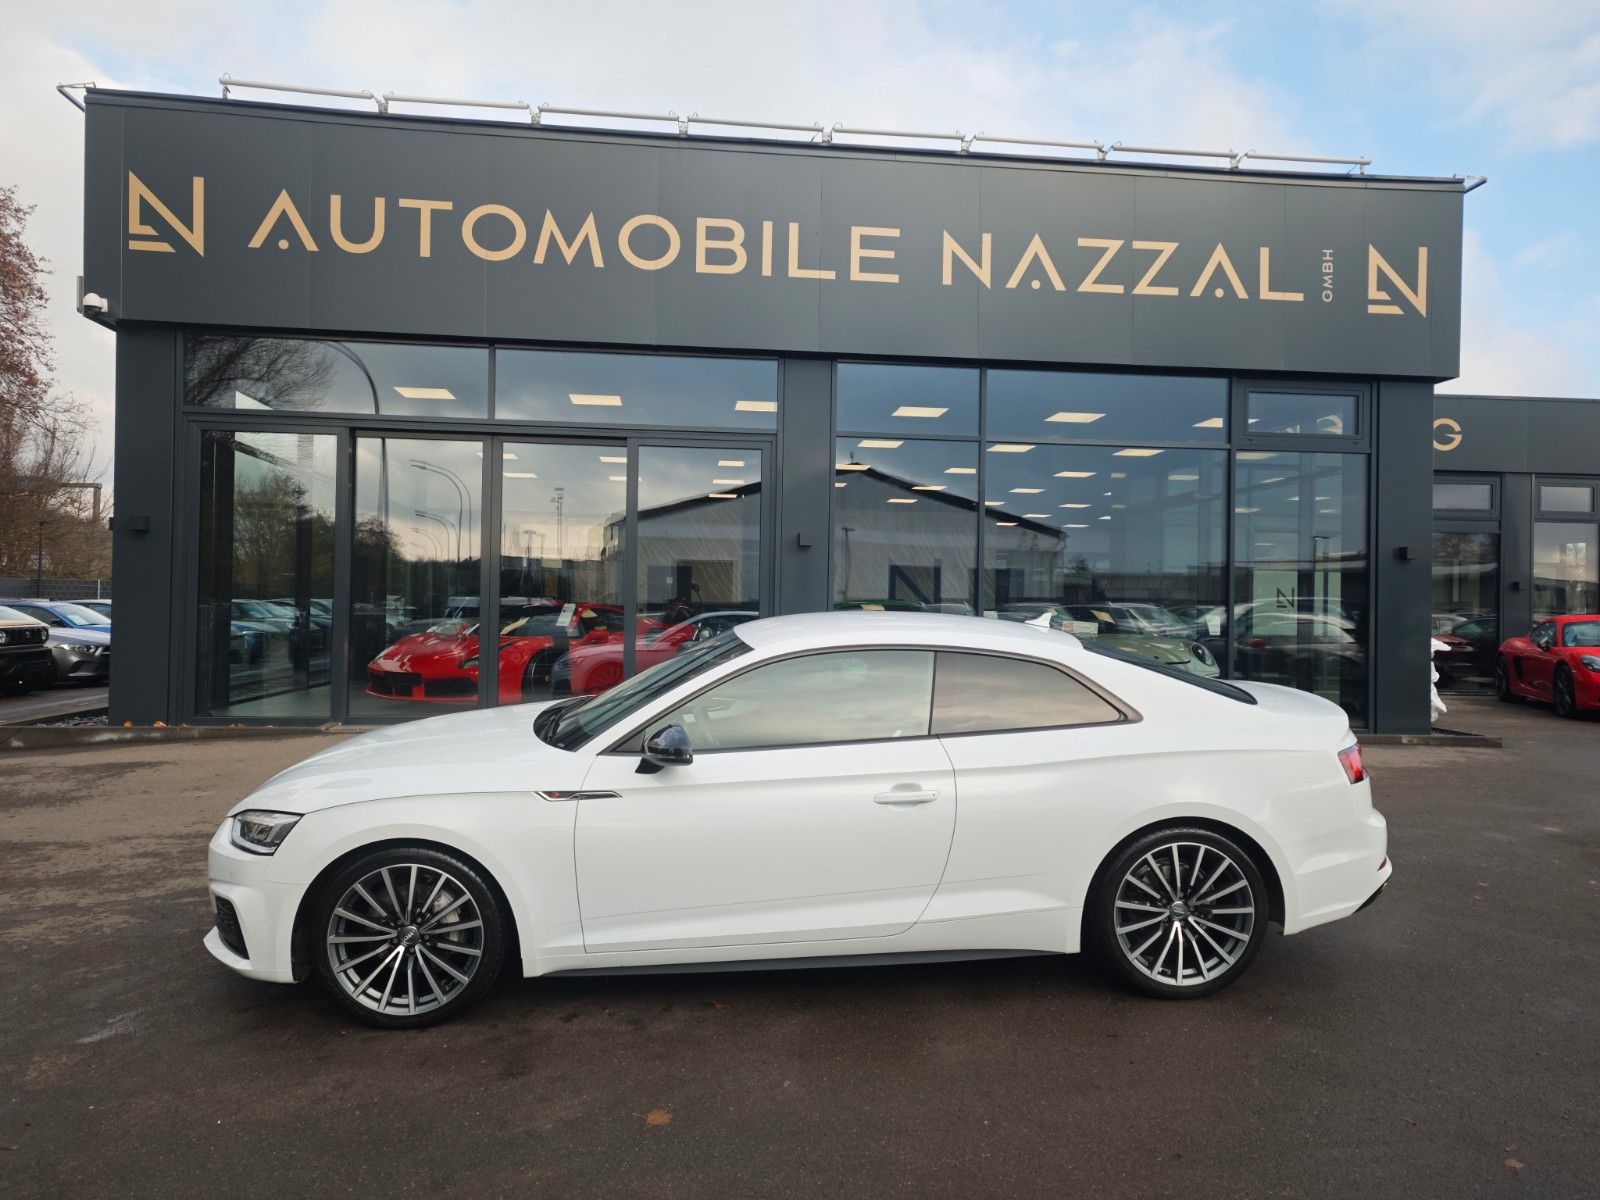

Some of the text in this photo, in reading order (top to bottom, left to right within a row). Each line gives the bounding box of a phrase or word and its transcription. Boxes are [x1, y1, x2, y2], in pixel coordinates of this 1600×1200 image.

[248, 188, 1304, 302] AUTOMOBILE NAZZAL
[1321, 248, 1334, 303] GMBH
